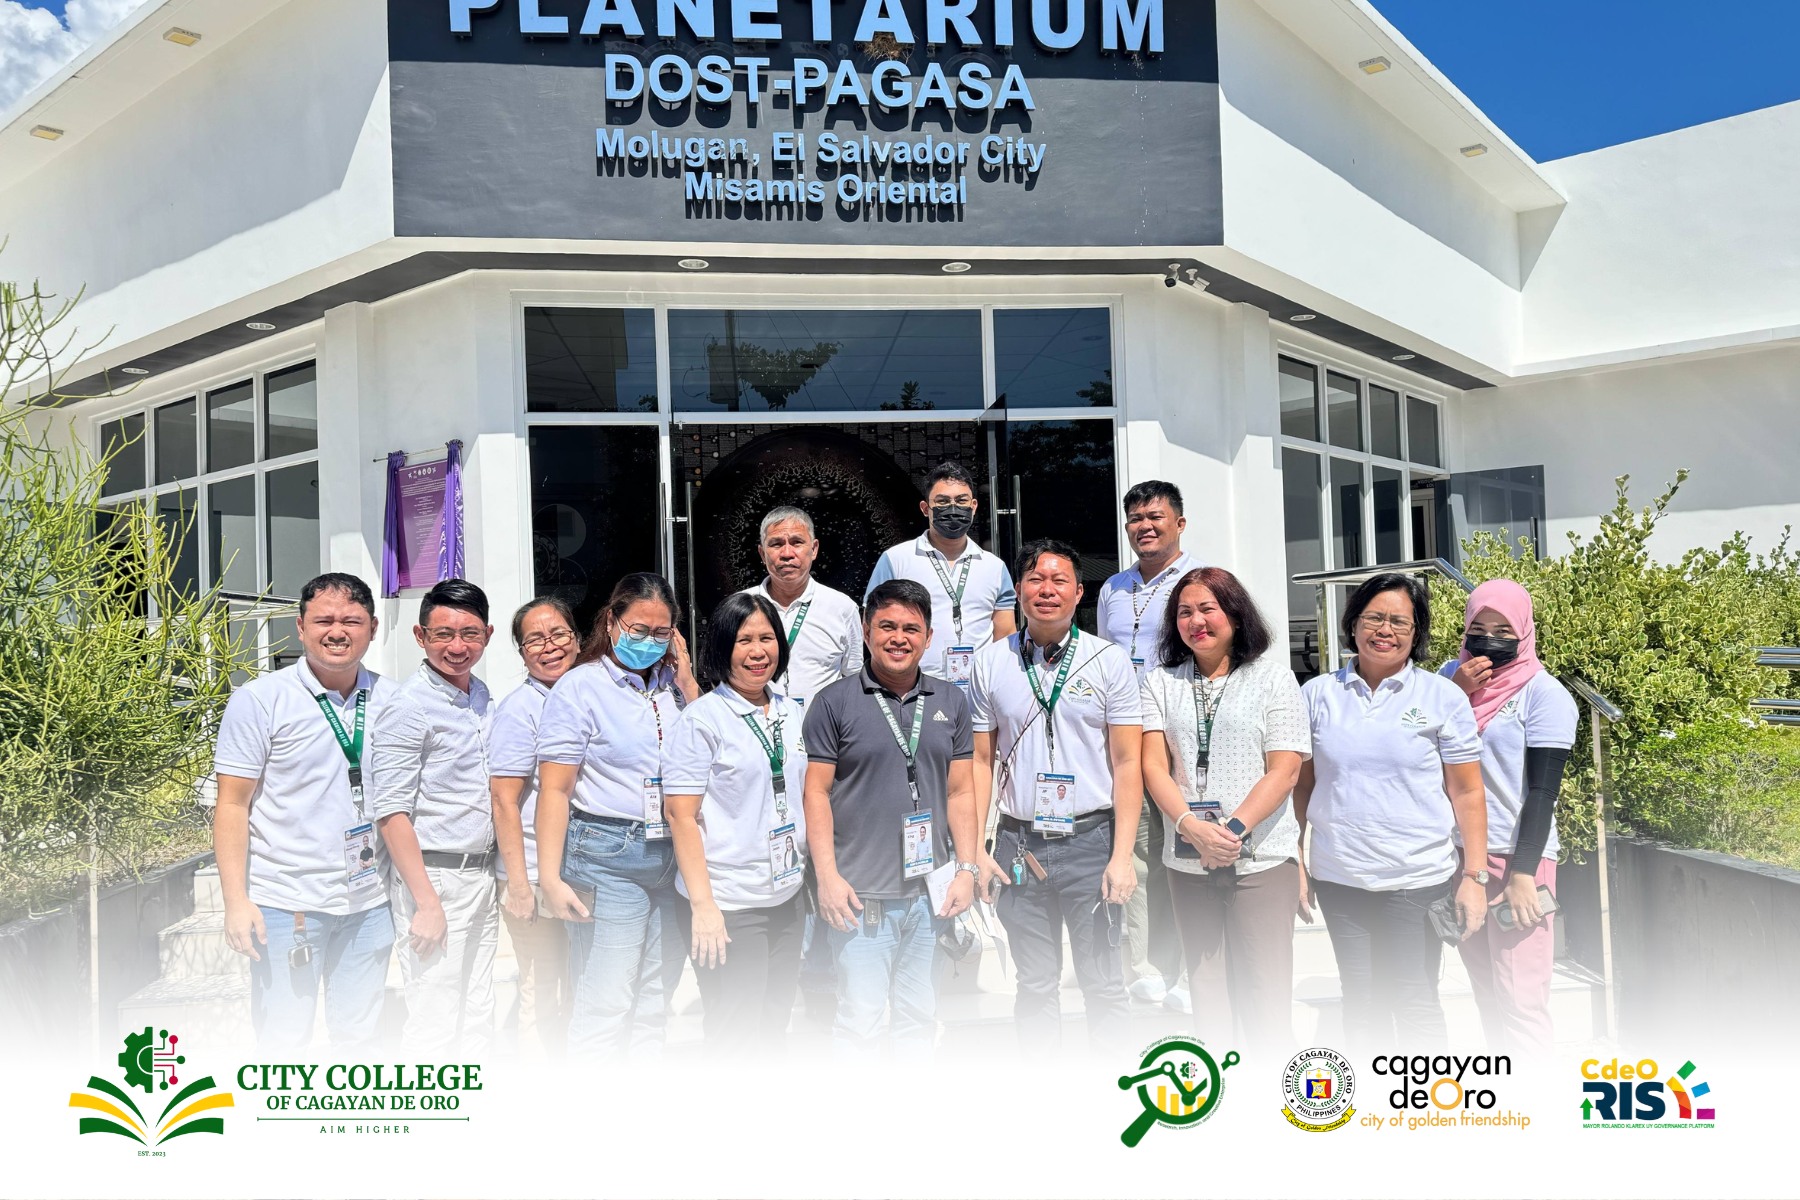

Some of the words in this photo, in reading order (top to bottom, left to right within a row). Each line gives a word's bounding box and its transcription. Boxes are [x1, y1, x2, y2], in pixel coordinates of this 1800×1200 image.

[606, 54, 1036, 109] DOST-PAGASA
[596, 128, 760, 166] Molugan,
[773, 132, 805, 160] El
[818, 132, 970, 163] Salvador
[981, 134, 1046, 172] City
[684, 172, 826, 202] Misamis
[837, 174, 966, 203] Oriental
[1054, 673, 1065, 687] AIM
[1060, 646, 1075, 671] HIGHER
[885, 713, 903, 738] CAGAYAN
[911, 720, 921, 738] AIM
[897, 736, 905, 746] DE
[900, 744, 911, 757] ORO
